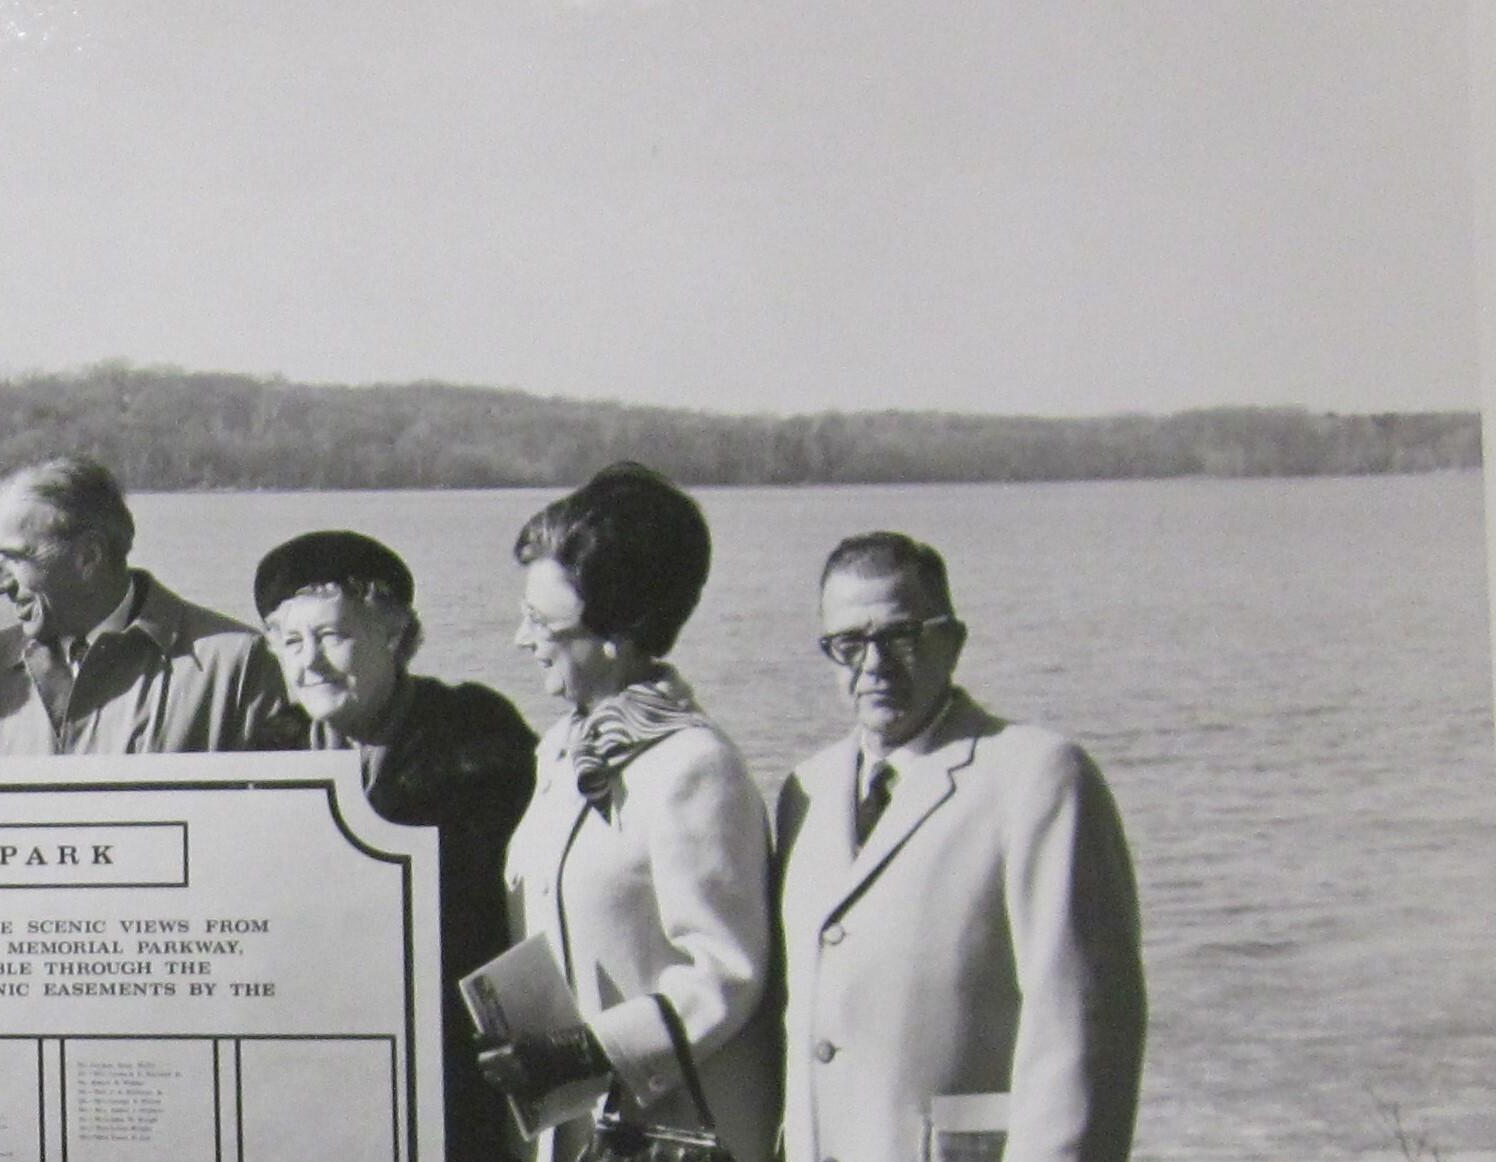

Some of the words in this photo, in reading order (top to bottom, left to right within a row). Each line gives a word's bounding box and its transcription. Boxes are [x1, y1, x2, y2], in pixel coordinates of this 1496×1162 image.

[27, 919, 107, 934] SCENIC
[119, 919, 190, 934] VIEWS
[205, 919, 270, 934] FROM
[7, 940, 124, 955] MEMORIAL
[43, 961, 152, 976] THROUGH
[164, 961, 211, 975] THE
[43, 982, 177, 997] EASEMENTS
[189, 982, 217, 997] BY
[229, 982, 276, 997] THE
